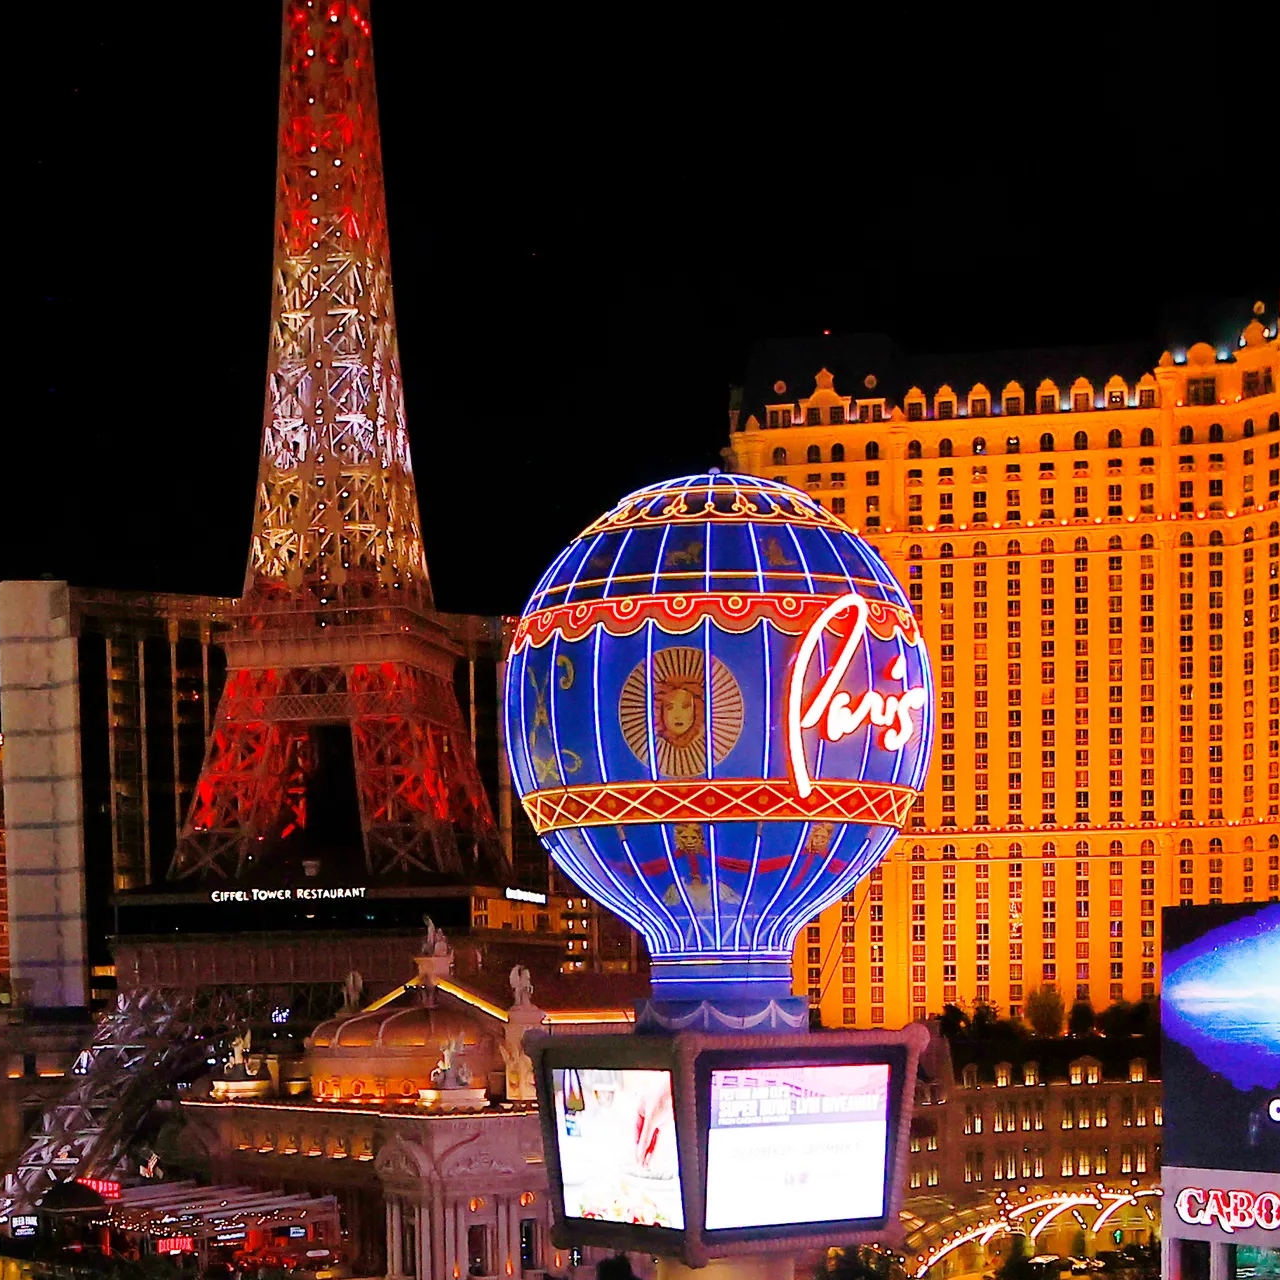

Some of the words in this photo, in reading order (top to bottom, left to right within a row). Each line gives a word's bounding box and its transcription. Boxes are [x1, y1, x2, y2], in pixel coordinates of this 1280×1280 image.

[790, 593, 926, 798] Paris
[211, 890, 249, 902] EIFFEL
[252, 888, 291, 900] TOWER
[297, 887, 367, 899] RESTAURANT
